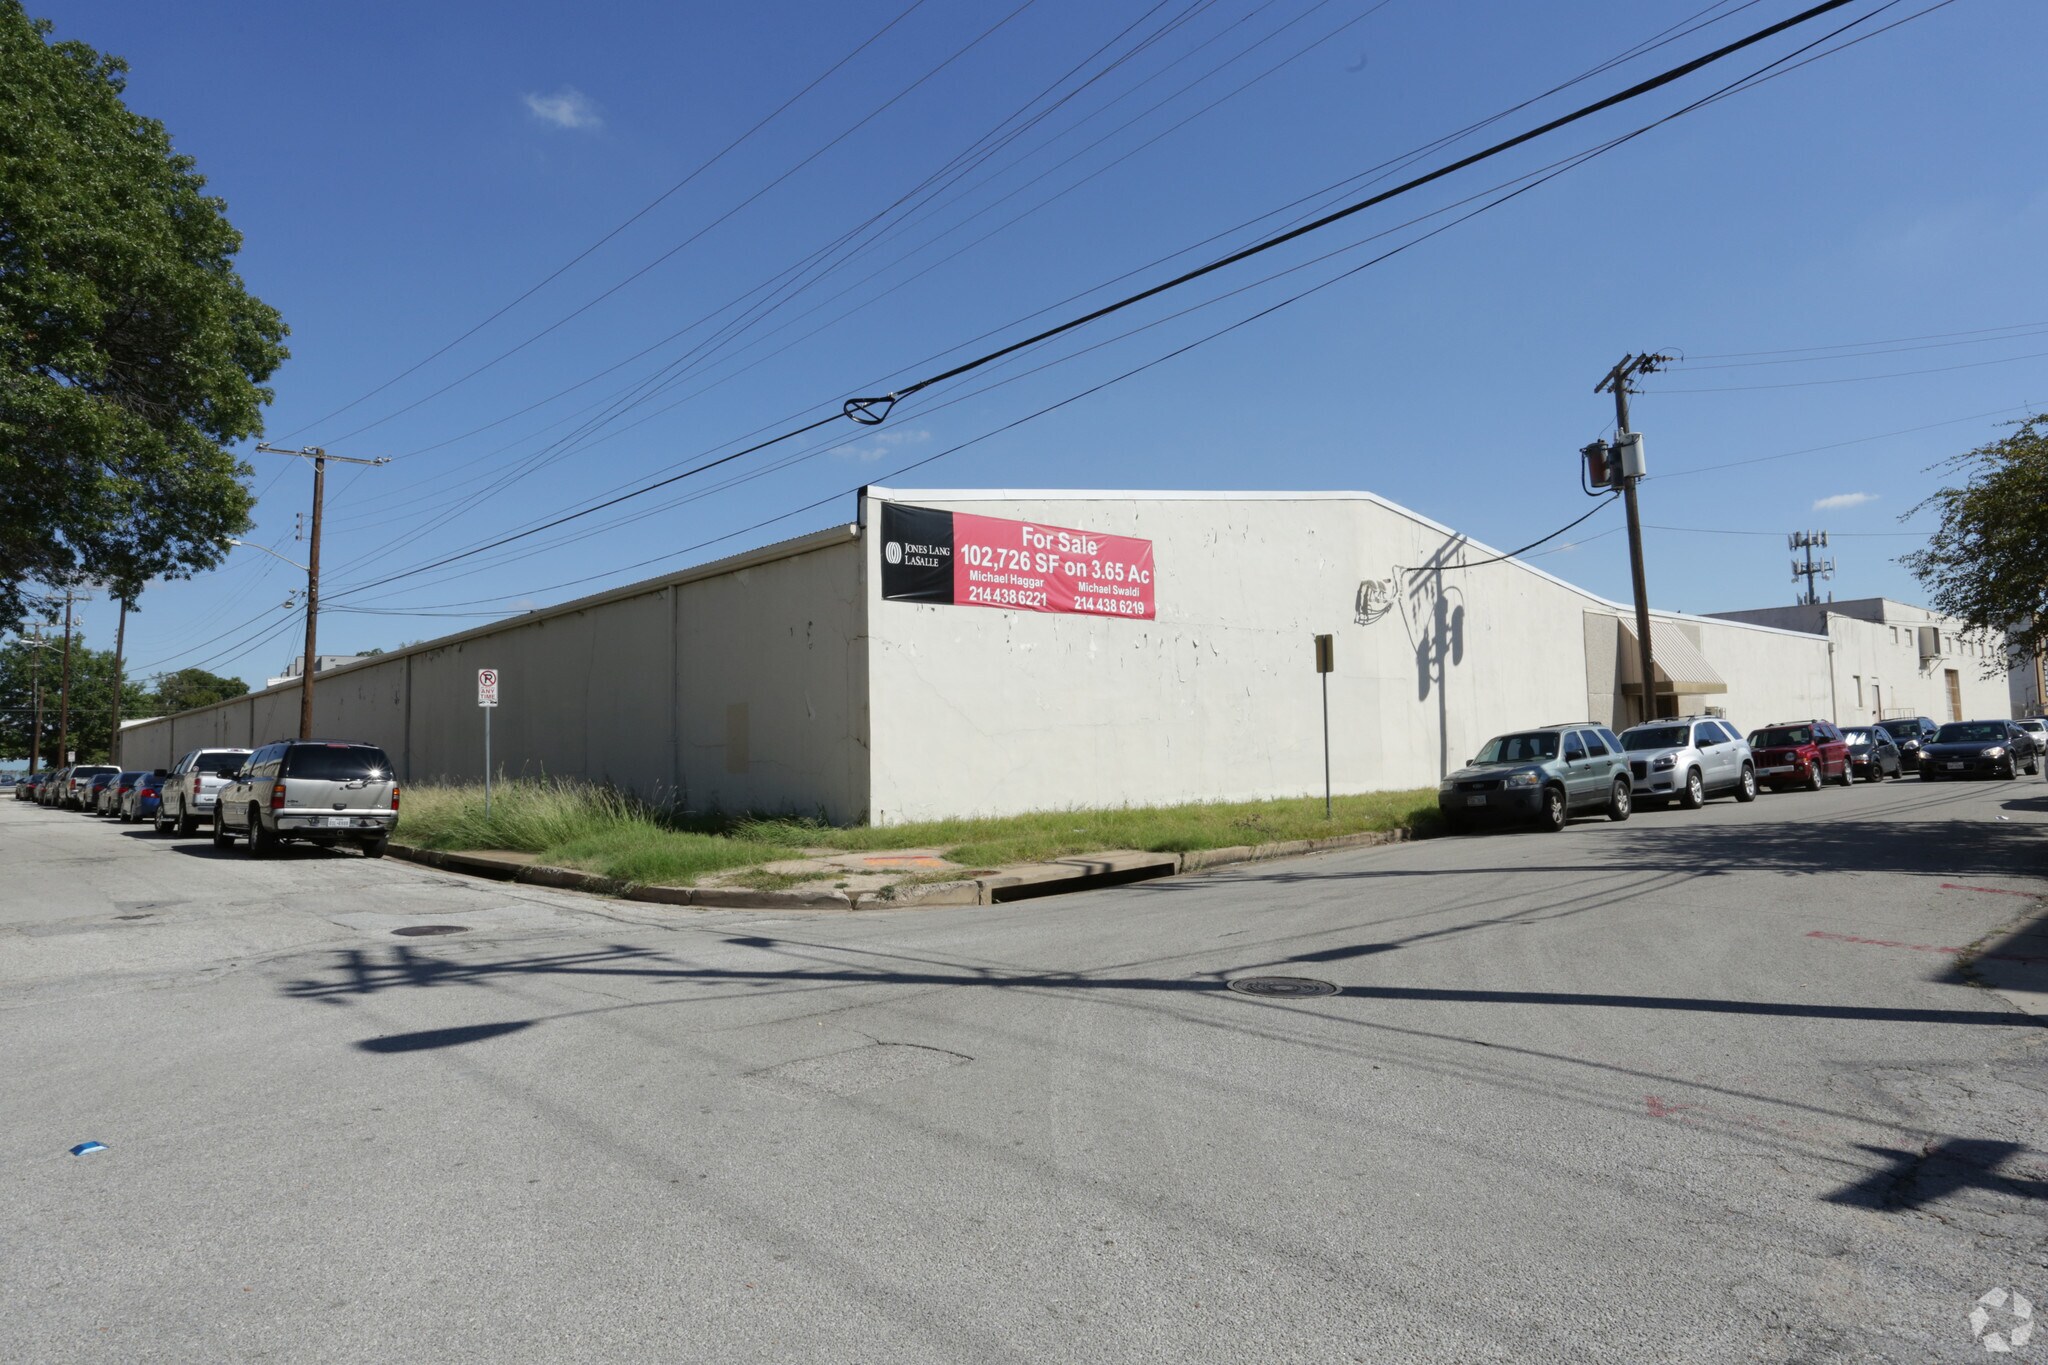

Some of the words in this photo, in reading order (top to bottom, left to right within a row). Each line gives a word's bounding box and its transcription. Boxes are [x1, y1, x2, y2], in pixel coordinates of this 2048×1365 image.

[904, 542, 927, 554] JONES
[929, 545, 950, 556] LANG
[1022, 526, 1053, 550] For
[1058, 532, 1098, 556] Sale
[961, 544, 1031, 571] 102,726
[1035, 552, 1060, 574] SF
[1064, 560, 1087, 577] on
[1091, 559, 1124, 581] 3.65
[1127, 564, 1150, 584] Ac
[969, 570, 1008, 584] Michael
[1010, 574, 1045, 589] Haggar
[1078, 581, 1111, 594] Michael
[1112, 585, 1140, 597] Swaldi
[969, 585, 992, 602] 214
[993, 588, 1017, 604] 438
[1018, 590, 1047, 606] 6221
[1074, 596, 1094, 610] 214
[1096, 598, 1117, 612] 438
[1119, 600, 1144, 615] 6219
